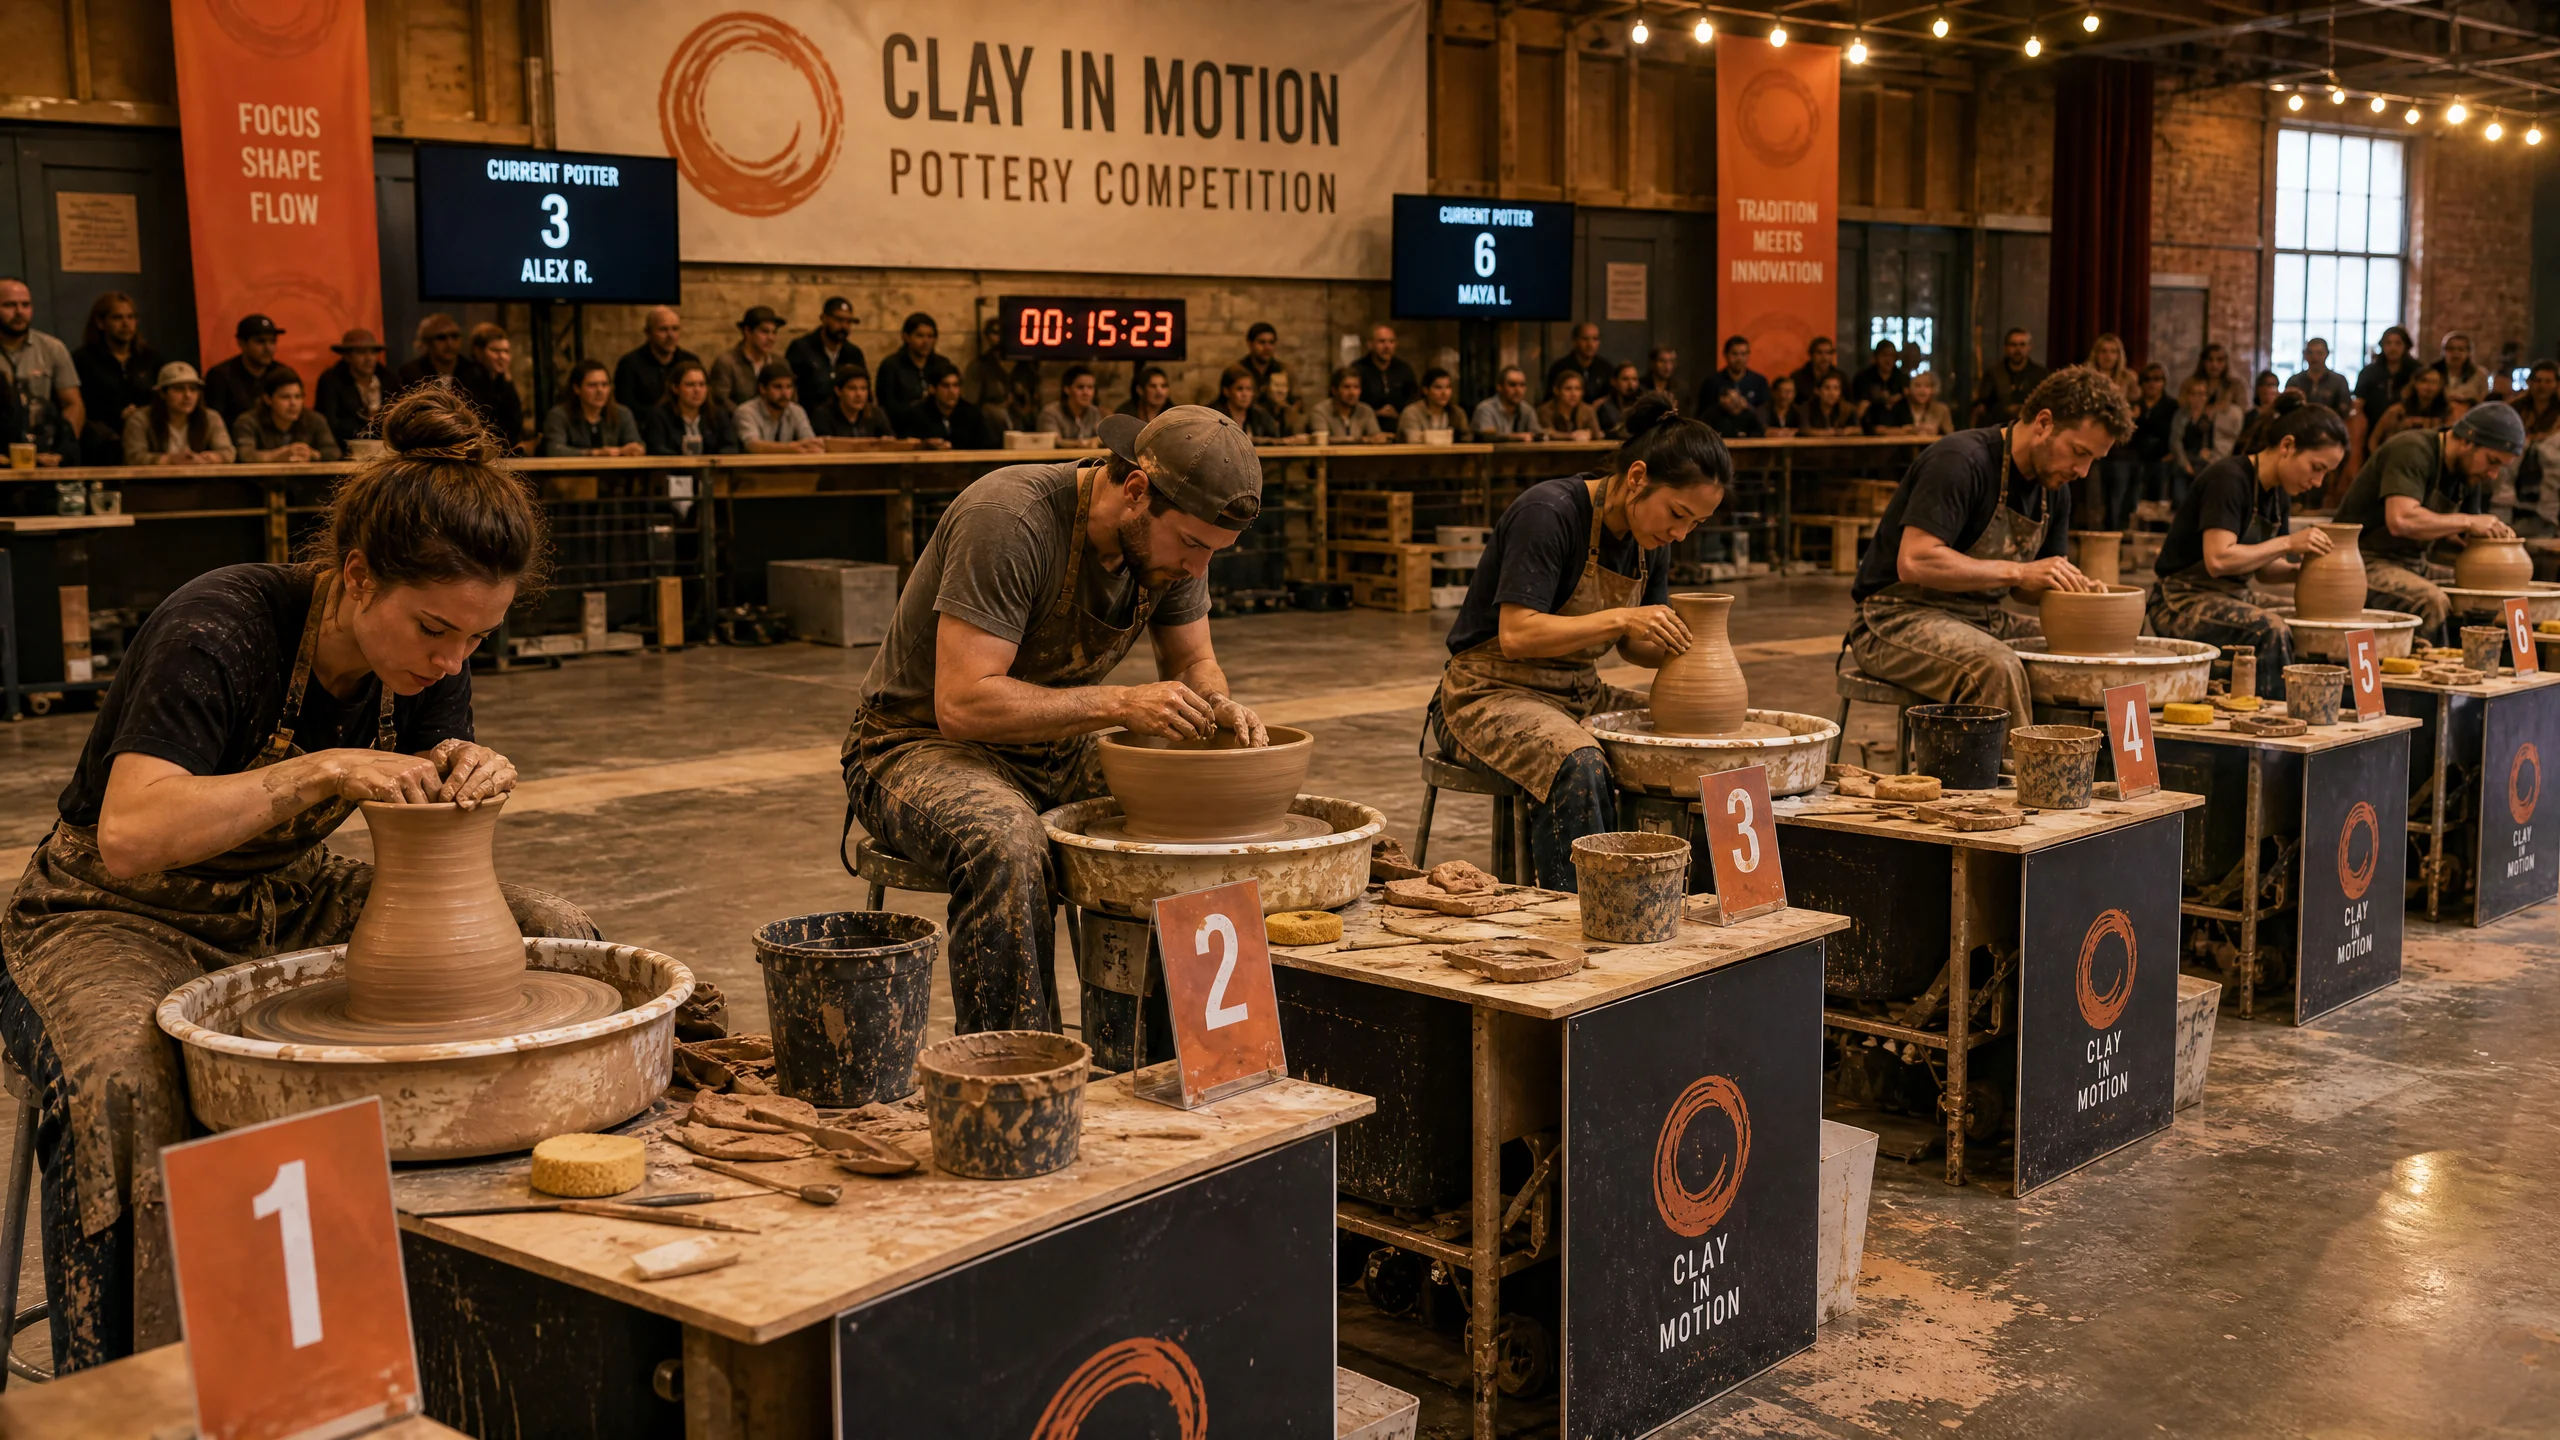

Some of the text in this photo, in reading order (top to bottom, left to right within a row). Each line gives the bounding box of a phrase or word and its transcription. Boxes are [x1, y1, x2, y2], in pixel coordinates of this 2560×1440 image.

[883, 33, 1338, 146] CLAY IN MOTION
[239, 103, 320, 137] FOCUS
[242, 147, 321, 180] SHAPE
[488, 159, 618, 186] CURRENT POTTER
[891, 149, 1335, 213] POTTERY COMPETITION
[251, 192, 318, 224] FLOW
[542, 194, 569, 248] 3
[1440, 206, 1533, 226] CURRENT POTTER
[1738, 199, 1817, 223] TRADITION
[1475, 233, 1495, 277] 6
[1754, 230, 1802, 252] MEETS
[521, 259, 592, 283] ALEX R.
[1732, 261, 1822, 283] INNOVATION
[1459, 285, 1511, 305] MAYA L.
[1020, 309, 1173, 347] 00:15:23
[2515, 609, 2528, 653] 6
[2358, 642, 2373, 693] 5
[2124, 701, 2143, 762] 4
[1727, 788, 1760, 872] 3
[2513, 826, 2531, 846] CLAY
[2508, 854, 2534, 877] MOTION
[2345, 901, 2368, 926] CLAY
[2352, 924, 2359, 939] IN
[2338, 934, 2372, 964] MOTION
[1195, 914, 1248, 1030] 2
[2088, 1030, 2121, 1063] CLAY
[2099, 1060, 2109, 1078] IN
[2077, 1072, 2128, 1112] MOTION
[254, 1160, 322, 1348] 1
[1673, 1233, 1728, 1285] CLAY
[1693, 1281, 1710, 1304] IN
[1660, 1286, 1740, 1353] MOTION
